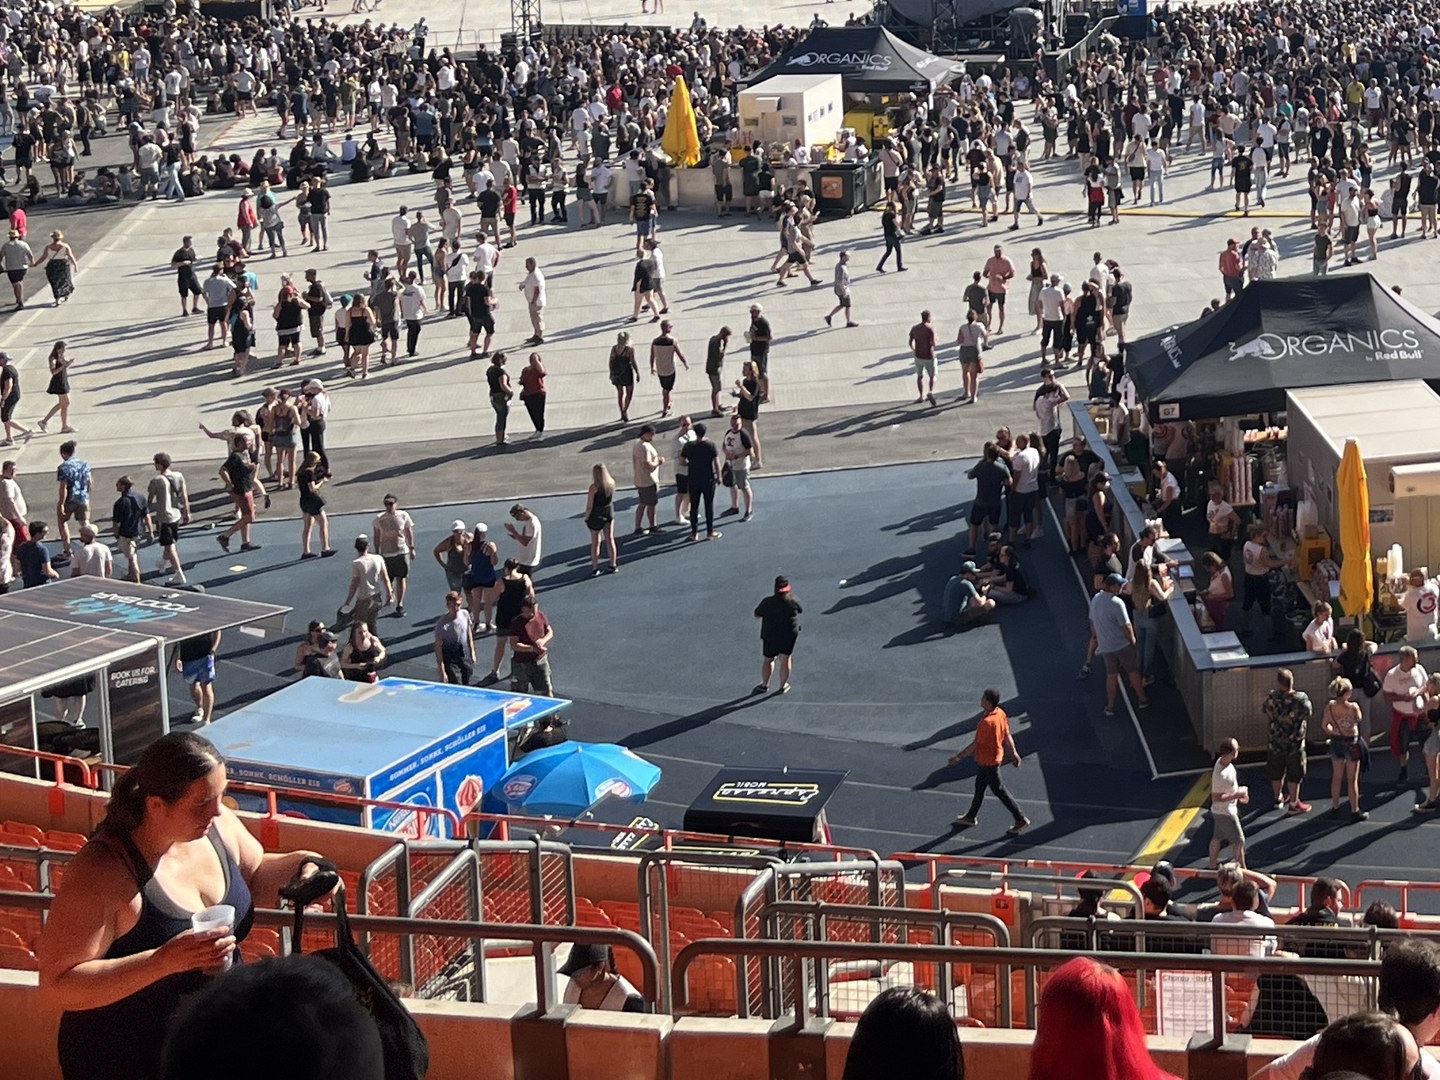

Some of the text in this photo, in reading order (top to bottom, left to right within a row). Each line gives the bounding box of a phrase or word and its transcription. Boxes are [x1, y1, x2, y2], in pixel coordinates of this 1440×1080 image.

[802, 51, 892, 67] ORGANICS
[1257, 328, 1420, 361] ORGANICS
[1375, 350, 1399, 361] Red
[1399, 349, 1422, 360] Bull
[136, 599, 200, 613] FOOD
[111, 666, 156, 681] BOOK US FOR
[115, 675, 149, 688] CATERING
[720, 787, 819, 800] Espresso
